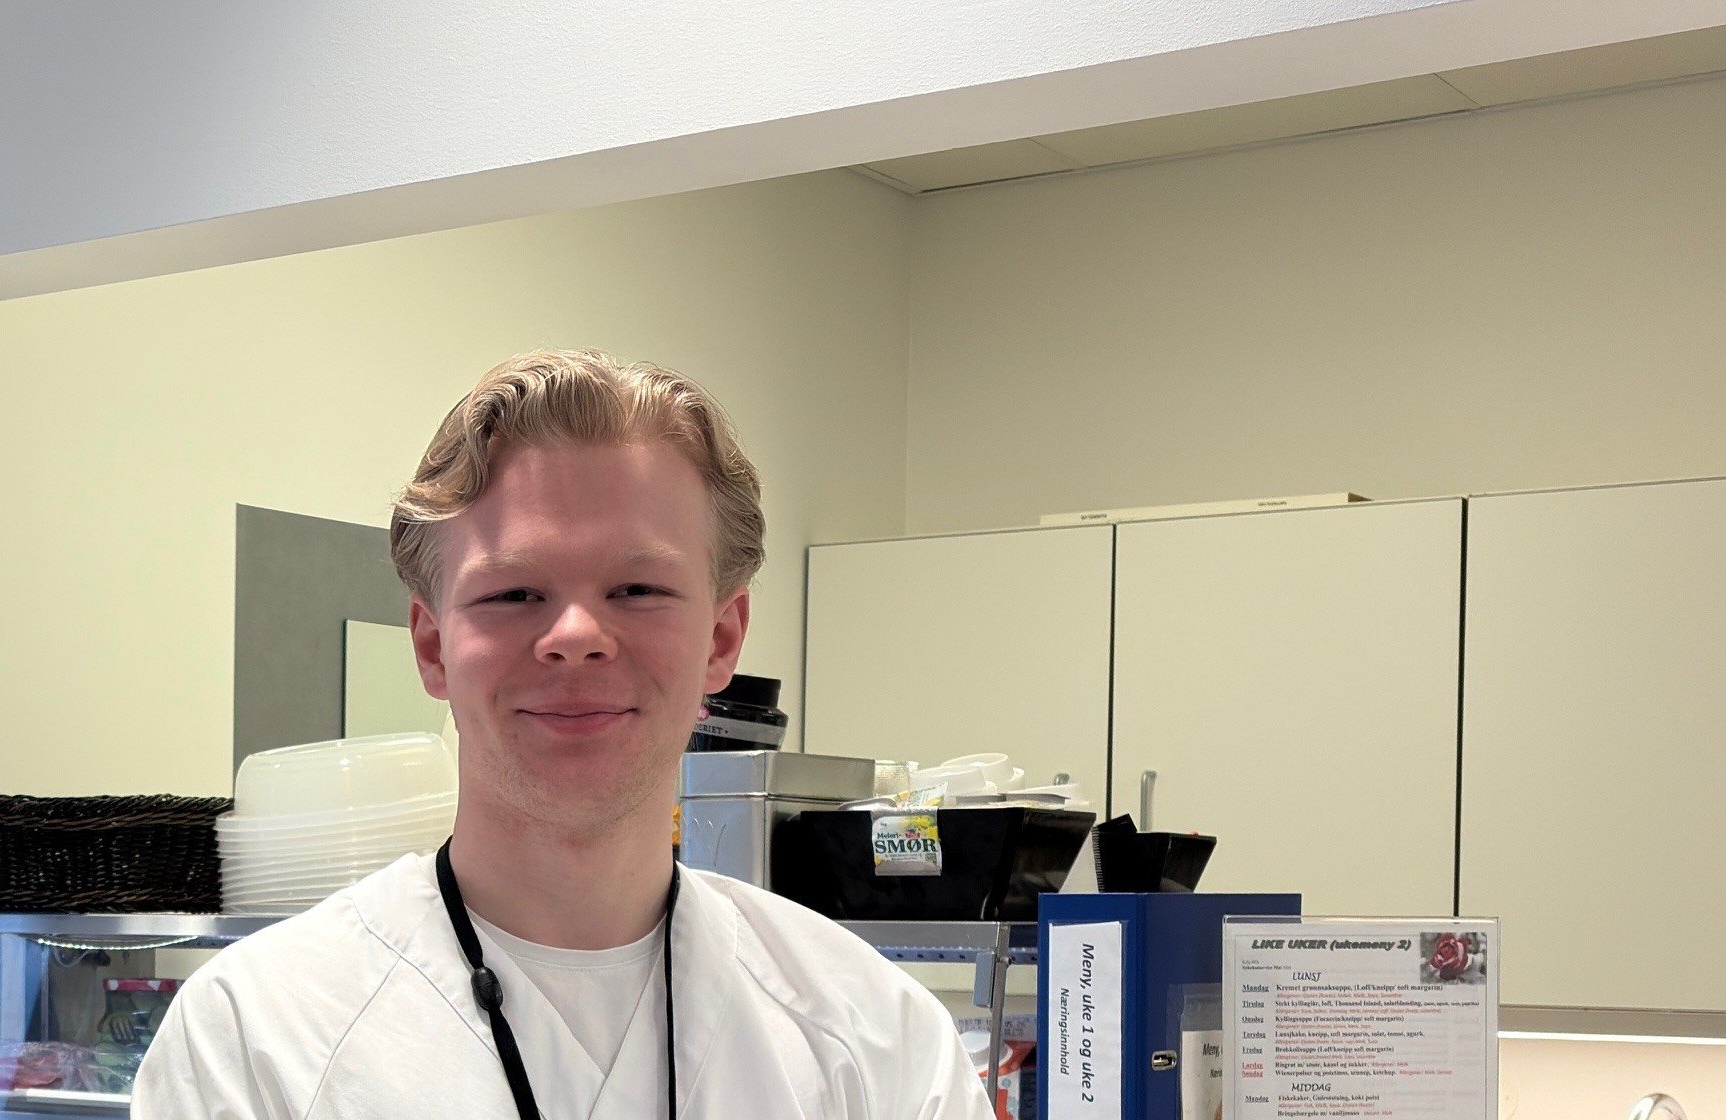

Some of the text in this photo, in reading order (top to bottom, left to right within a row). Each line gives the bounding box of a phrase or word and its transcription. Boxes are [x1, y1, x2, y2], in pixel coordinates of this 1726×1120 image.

[694, 723, 723, 734] ERIET
[875, 839, 937, 853] SMØR
[1252, 940, 1285, 949] LIKE
[1288, 940, 1327, 949] UKER
[1397, 940, 1411, 951] 2)
[1292, 972, 1321, 982] LUNSJ
[1242, 984, 1269, 992] Mandag
[1080, 943, 1094, 1103] Meny, uke 1 og uke 2
[1060, 988, 1070, 1075] Næringsinnhold
[1291, 1083, 1331, 1092] MIDDAG
